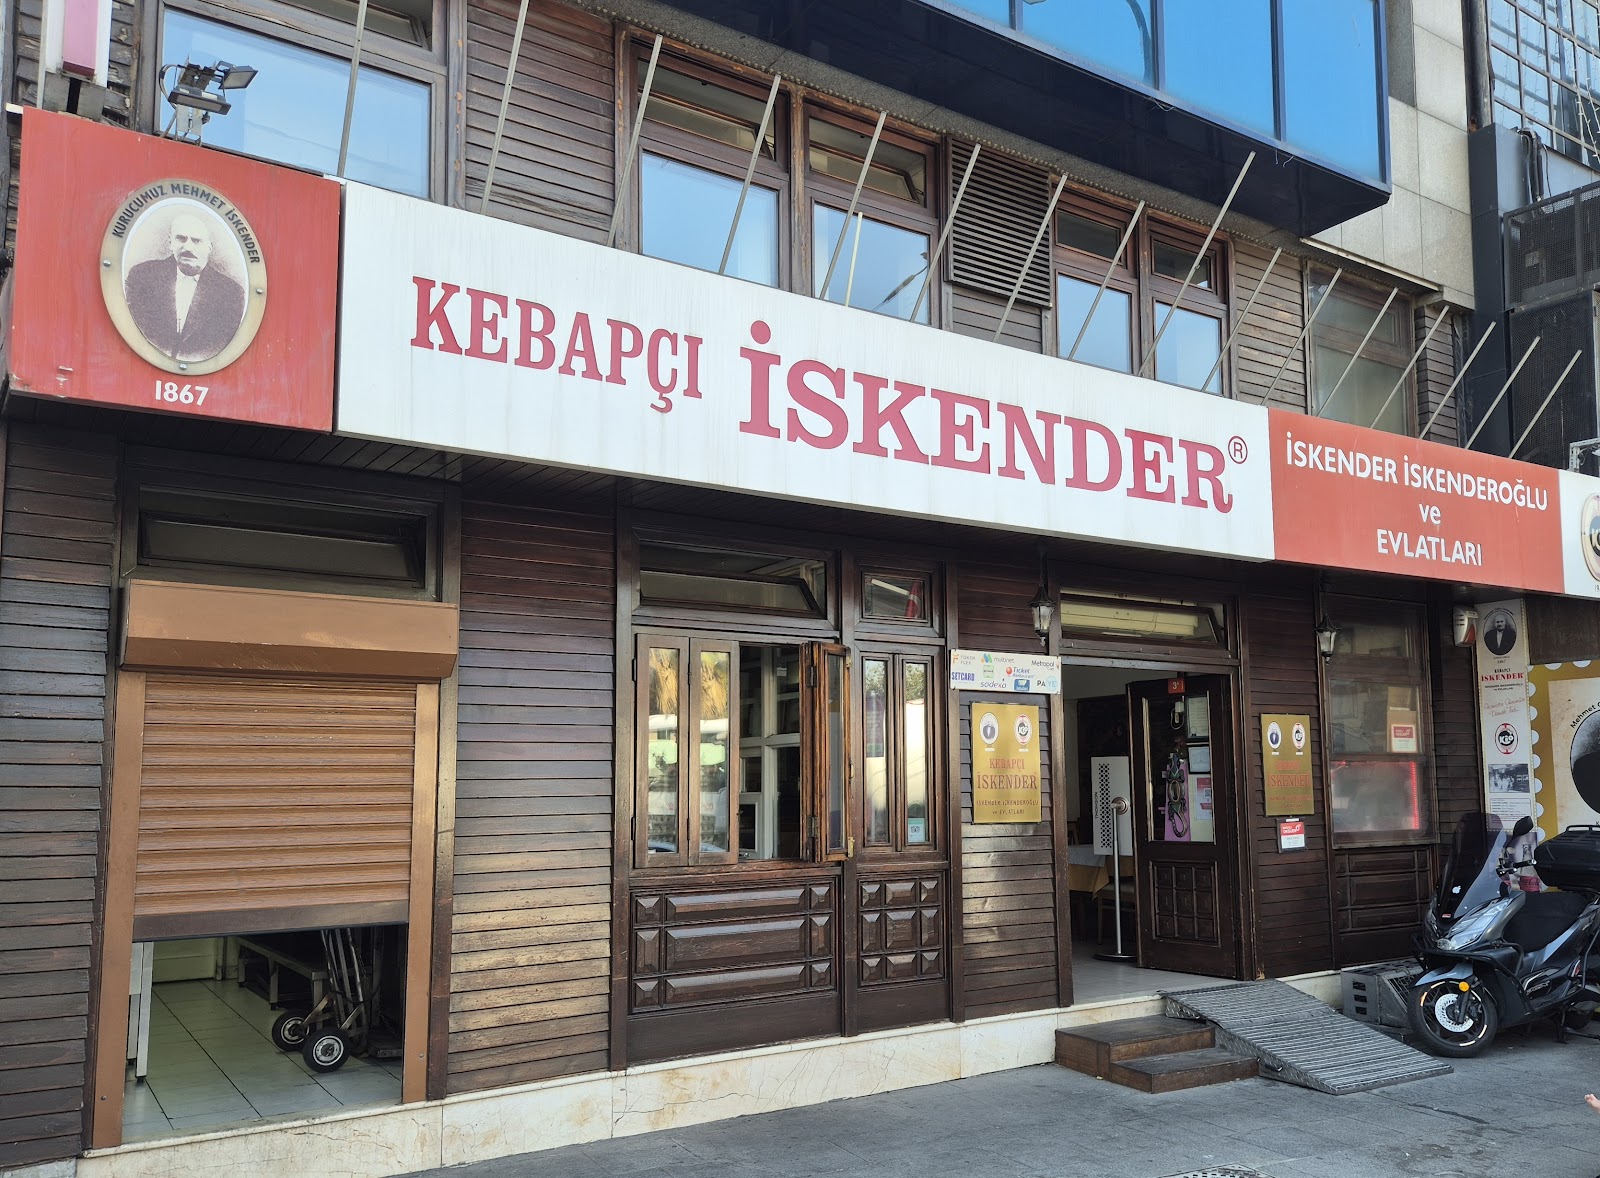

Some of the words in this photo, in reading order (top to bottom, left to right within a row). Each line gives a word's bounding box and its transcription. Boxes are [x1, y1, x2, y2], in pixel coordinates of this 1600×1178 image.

[112, 185, 167, 238] KURUCUMUZ
[171, 183, 226, 210] MEHMET
[224, 208, 260, 264] İSKENDER
[155, 380, 209, 406] 1867
[410, 275, 703, 414] KEBAPÇI
[739, 320, 1233, 513] İSKENDER
[1286, 431, 1398, 484] İSKENDER
[1403, 455, 1548, 511] İSKENDEROĞLU
[1418, 503, 1441, 525] ve
[1377, 528, 1483, 567] EVLATLARI
[951, 671, 975, 682] SETCARD
[1570, 705, 1597, 730] Mehmet
[976, 771, 1038, 790] İSKENDER
